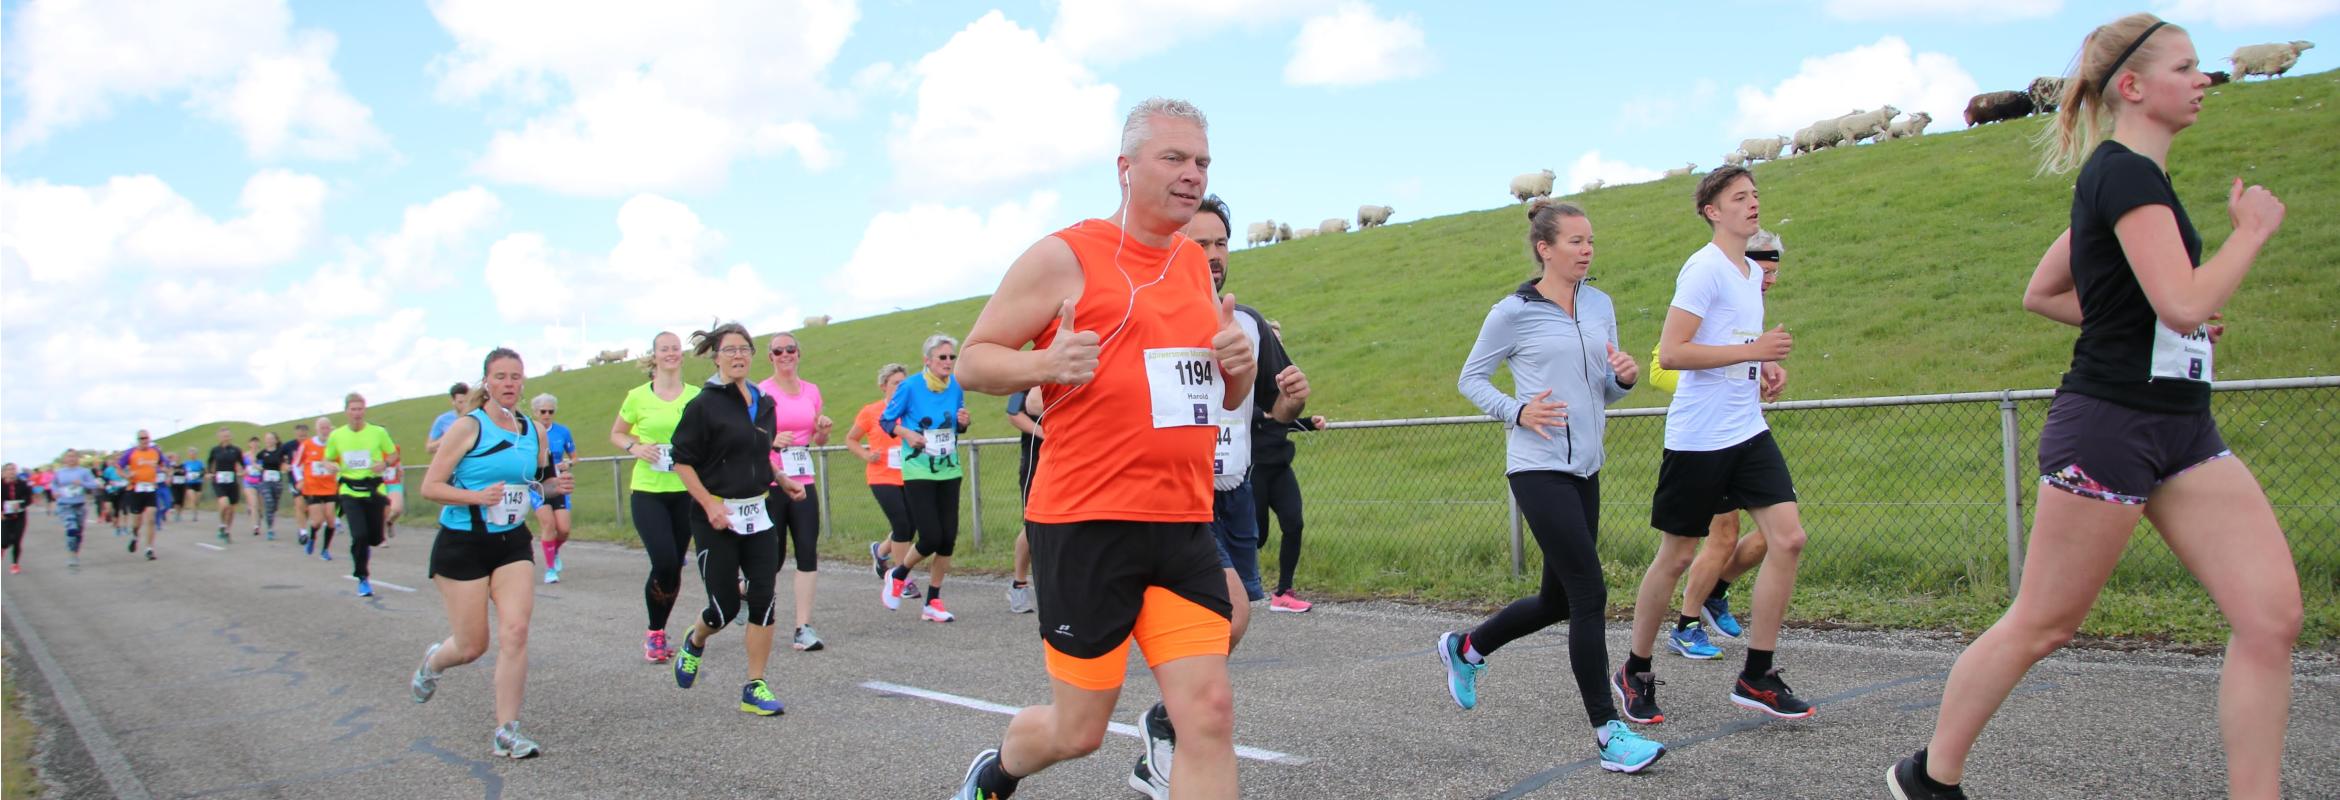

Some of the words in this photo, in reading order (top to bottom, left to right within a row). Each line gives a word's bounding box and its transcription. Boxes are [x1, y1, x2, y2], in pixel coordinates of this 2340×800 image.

[1175, 360, 1213, 386] 1194
[1216, 426, 1232, 446] 44
[503, 491, 524, 505] 1143
[738, 503, 760, 517] 1076
